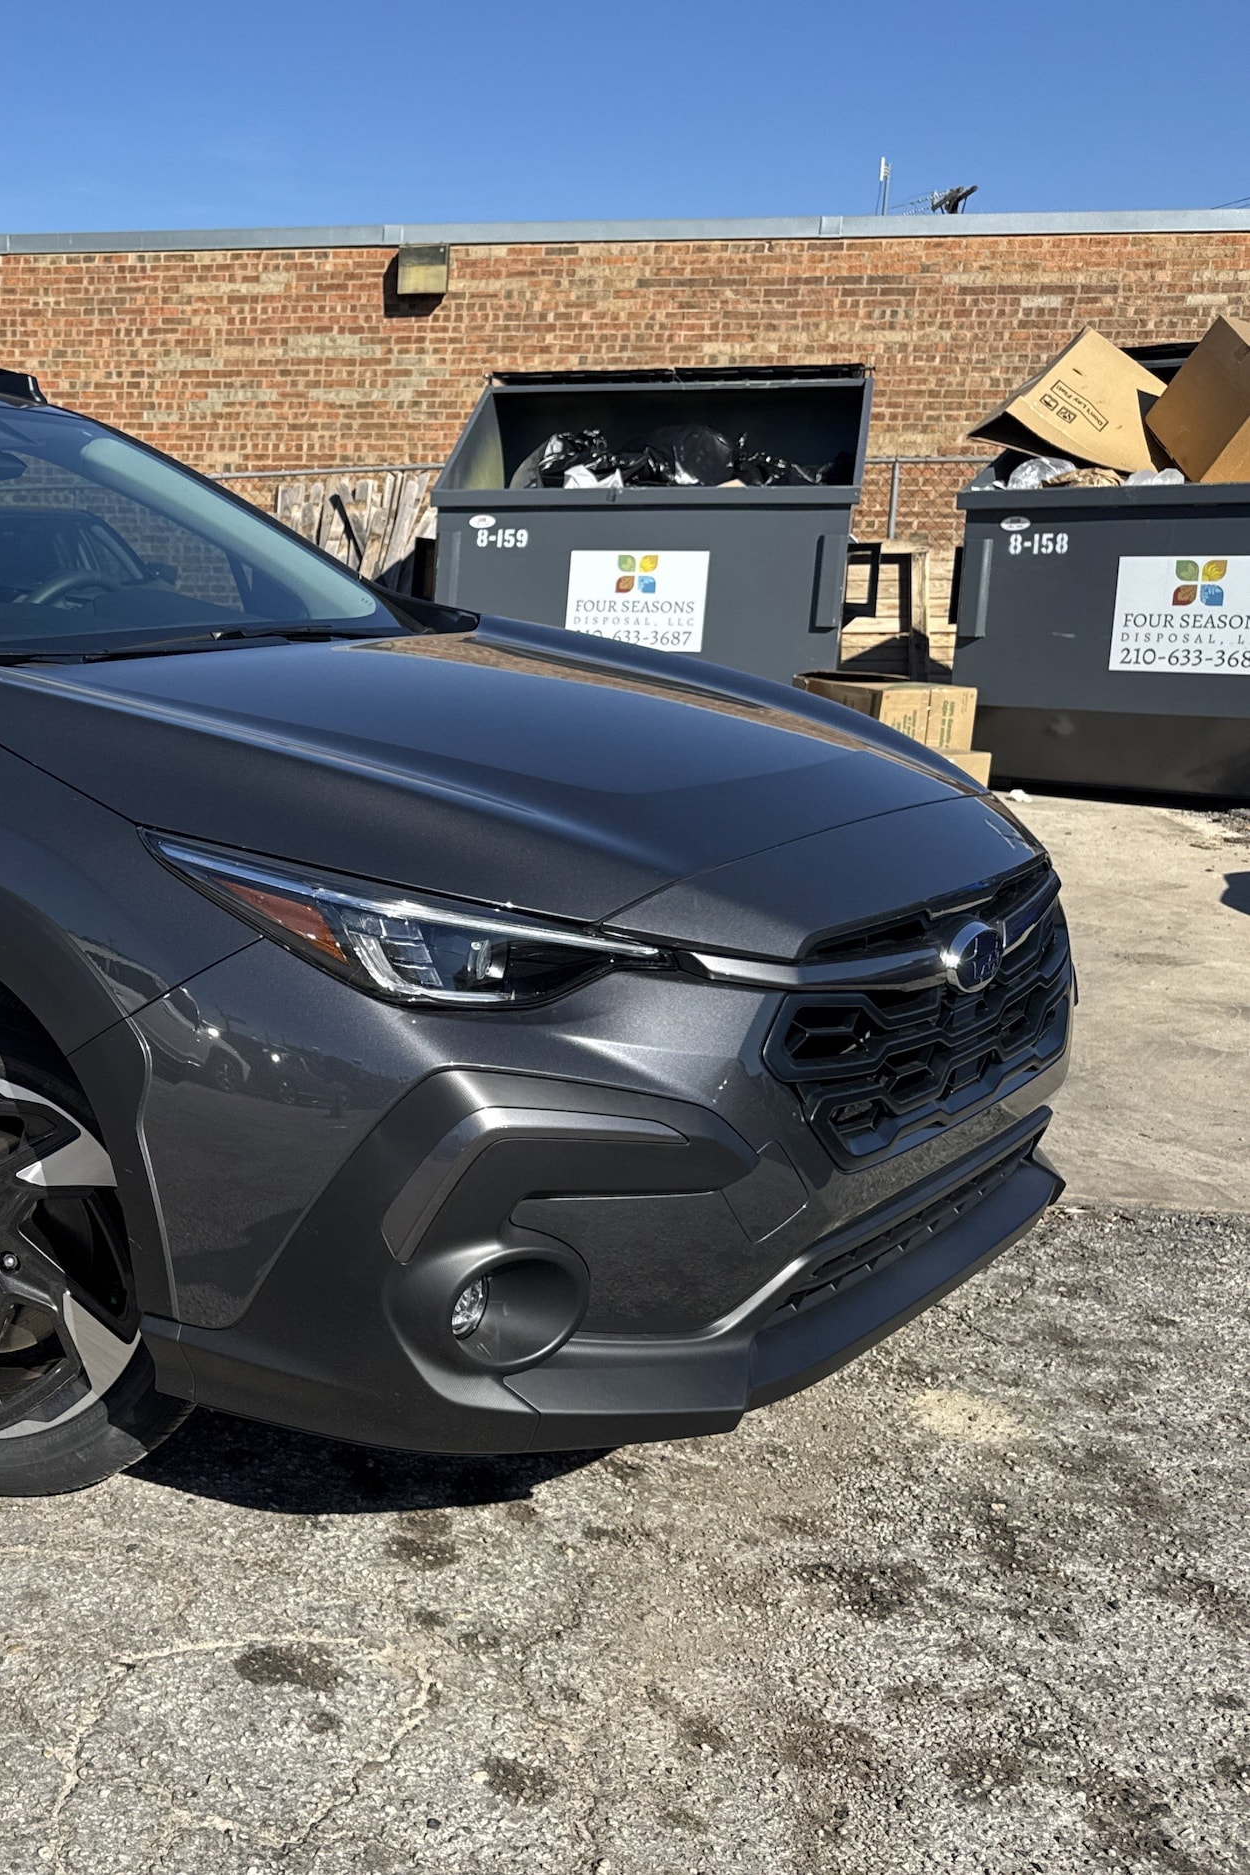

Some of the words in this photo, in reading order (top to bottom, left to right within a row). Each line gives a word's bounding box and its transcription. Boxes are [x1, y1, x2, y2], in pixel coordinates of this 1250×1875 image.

[476, 528, 529, 548] 8-159
[1009, 532, 1069, 555] 8-158
[575, 600, 617, 613] FOUR
[621, 600, 695, 614] SEASONS
[667, 617, 695, 627] LLC
[1123, 613, 1174, 628] FOUR
[1121, 632, 1224, 645] DISPOSAL,
